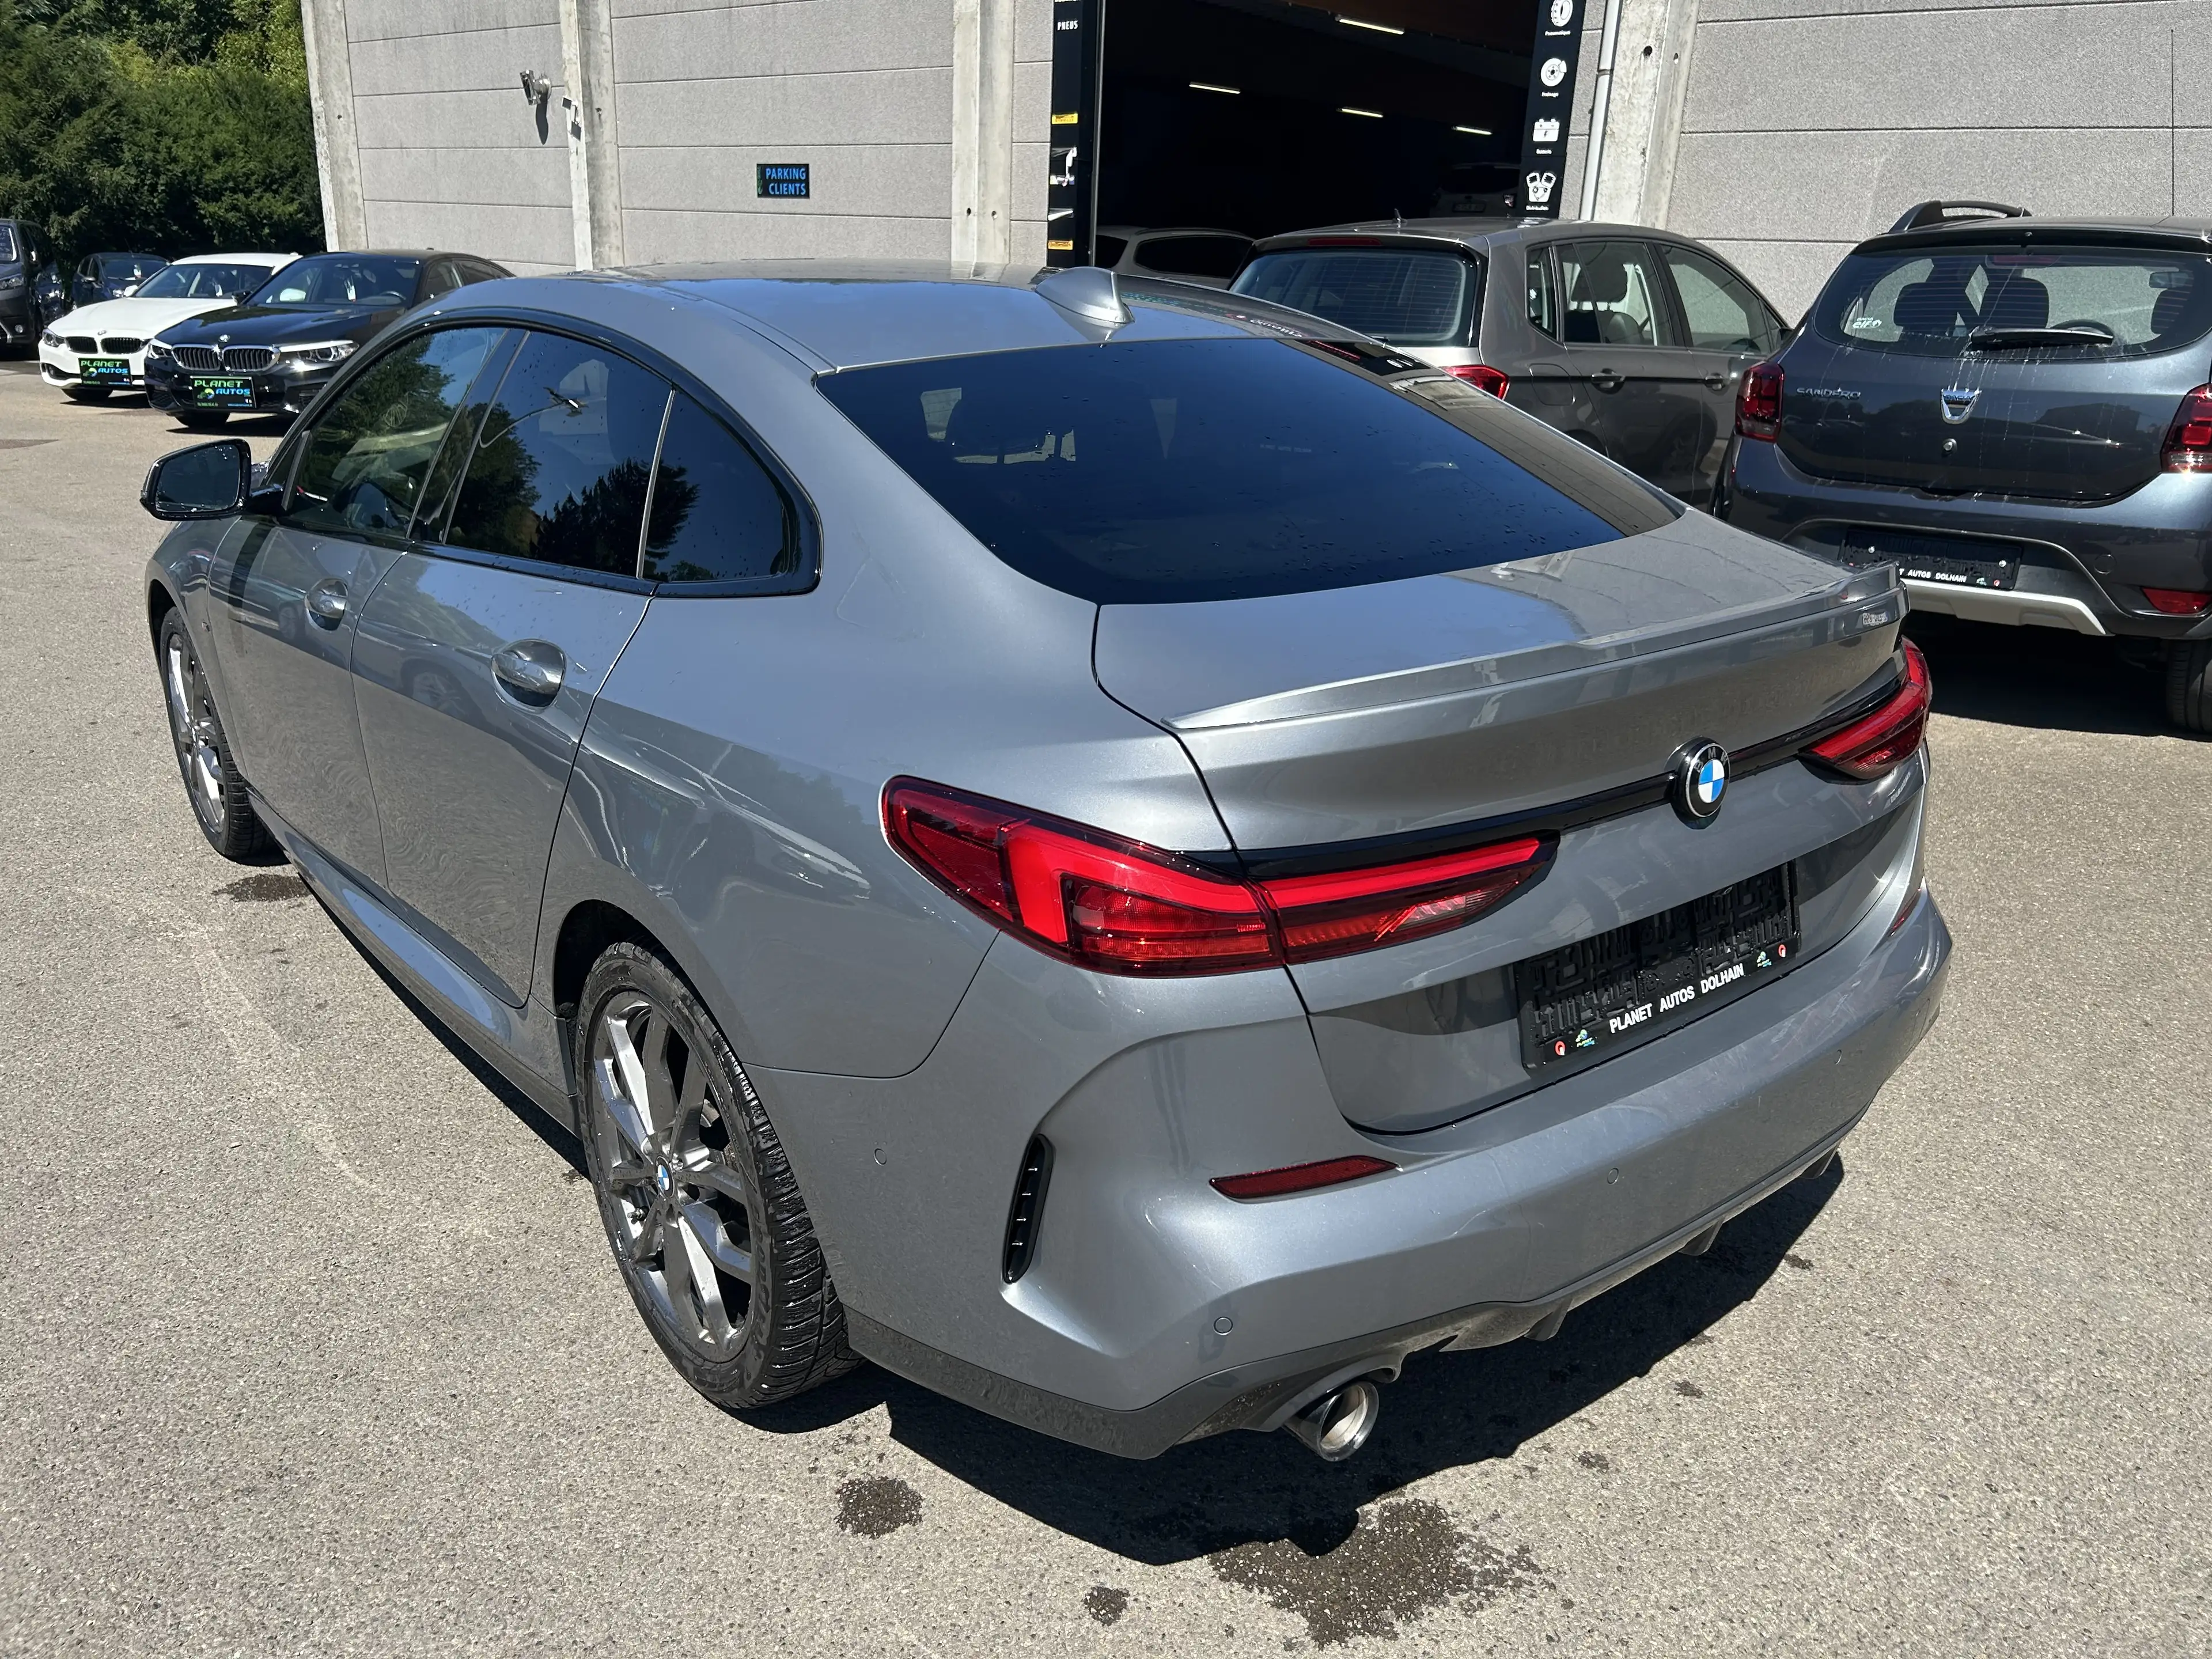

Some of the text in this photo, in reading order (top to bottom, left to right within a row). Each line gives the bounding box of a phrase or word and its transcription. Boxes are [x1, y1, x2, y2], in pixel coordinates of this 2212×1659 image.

[1057, 20, 1078, 31] PNEUS
[766, 168, 806, 180] PARKING
[768, 183, 806, 195] CLIENTS
[194, 380, 243, 388] PLANET
[1797, 388, 1861, 399] SANDERO
[1907, 569, 1931, 578] AUTOS
[1936, 572, 1967, 583] DOLHAIN
[1694, 747, 1728, 773] BMW
[1609, 963, 1744, 1033] PLANET AUTOS DOLHAIN
